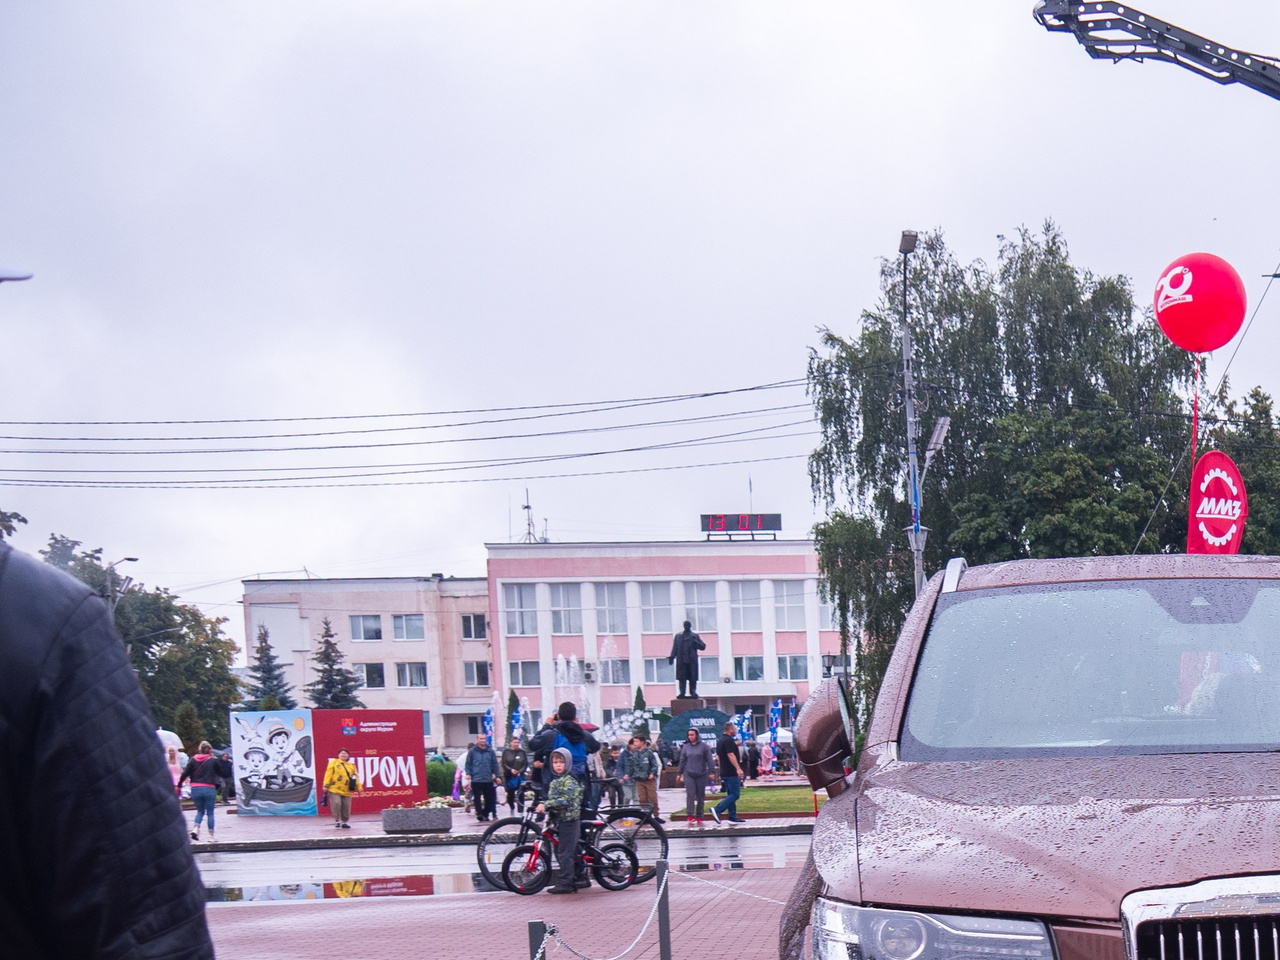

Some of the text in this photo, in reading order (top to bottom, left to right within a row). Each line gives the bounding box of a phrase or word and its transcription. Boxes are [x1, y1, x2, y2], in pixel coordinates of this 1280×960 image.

[709, 514, 761, 531] 13 01
[327, 756, 419, 788] УРОМ
